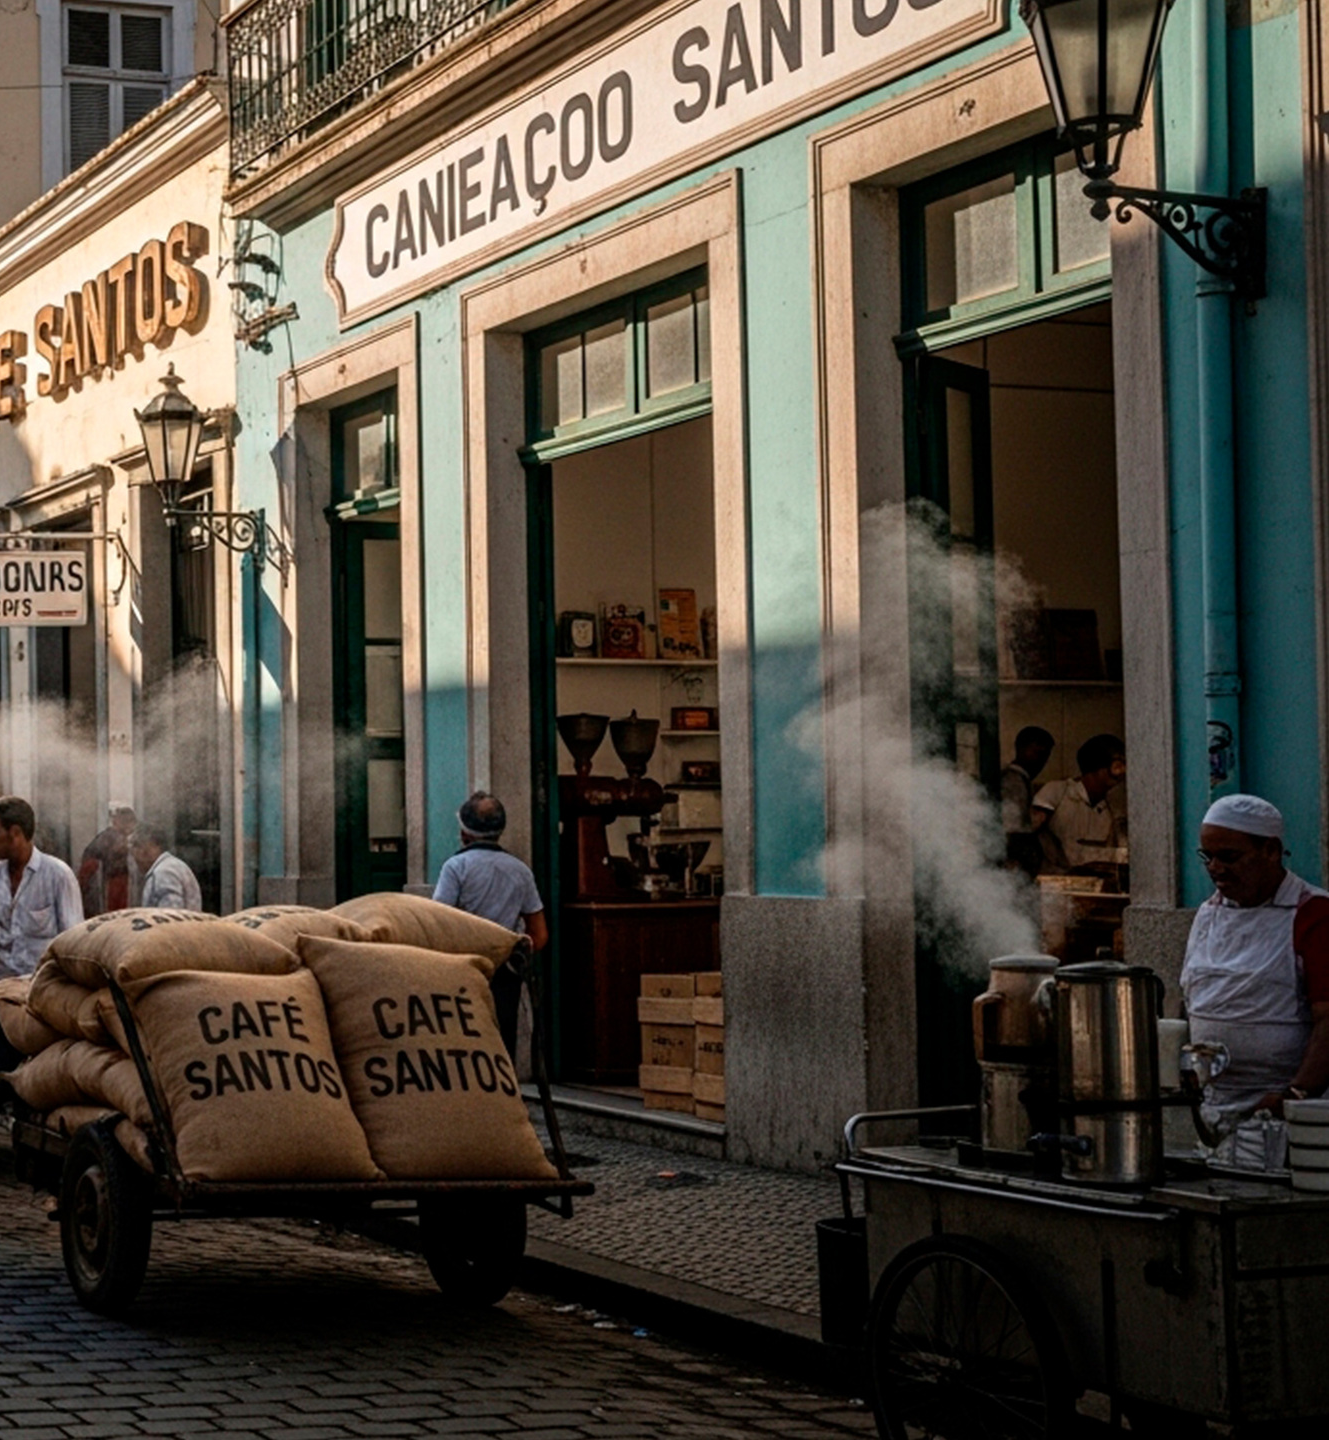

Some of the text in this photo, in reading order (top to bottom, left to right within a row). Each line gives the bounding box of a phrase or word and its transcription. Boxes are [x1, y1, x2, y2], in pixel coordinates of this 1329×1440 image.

[365, 0, 943, 279] CANIEAÇOO SAN
[34, 220, 210, 399] SANTOS
[198, 996, 310, 1044] CAFÉ
[373, 986, 481, 1040] CAFÉ
[184, 1049, 342, 1100] SANTOS
[364, 1048, 517, 1097] SANTOS
